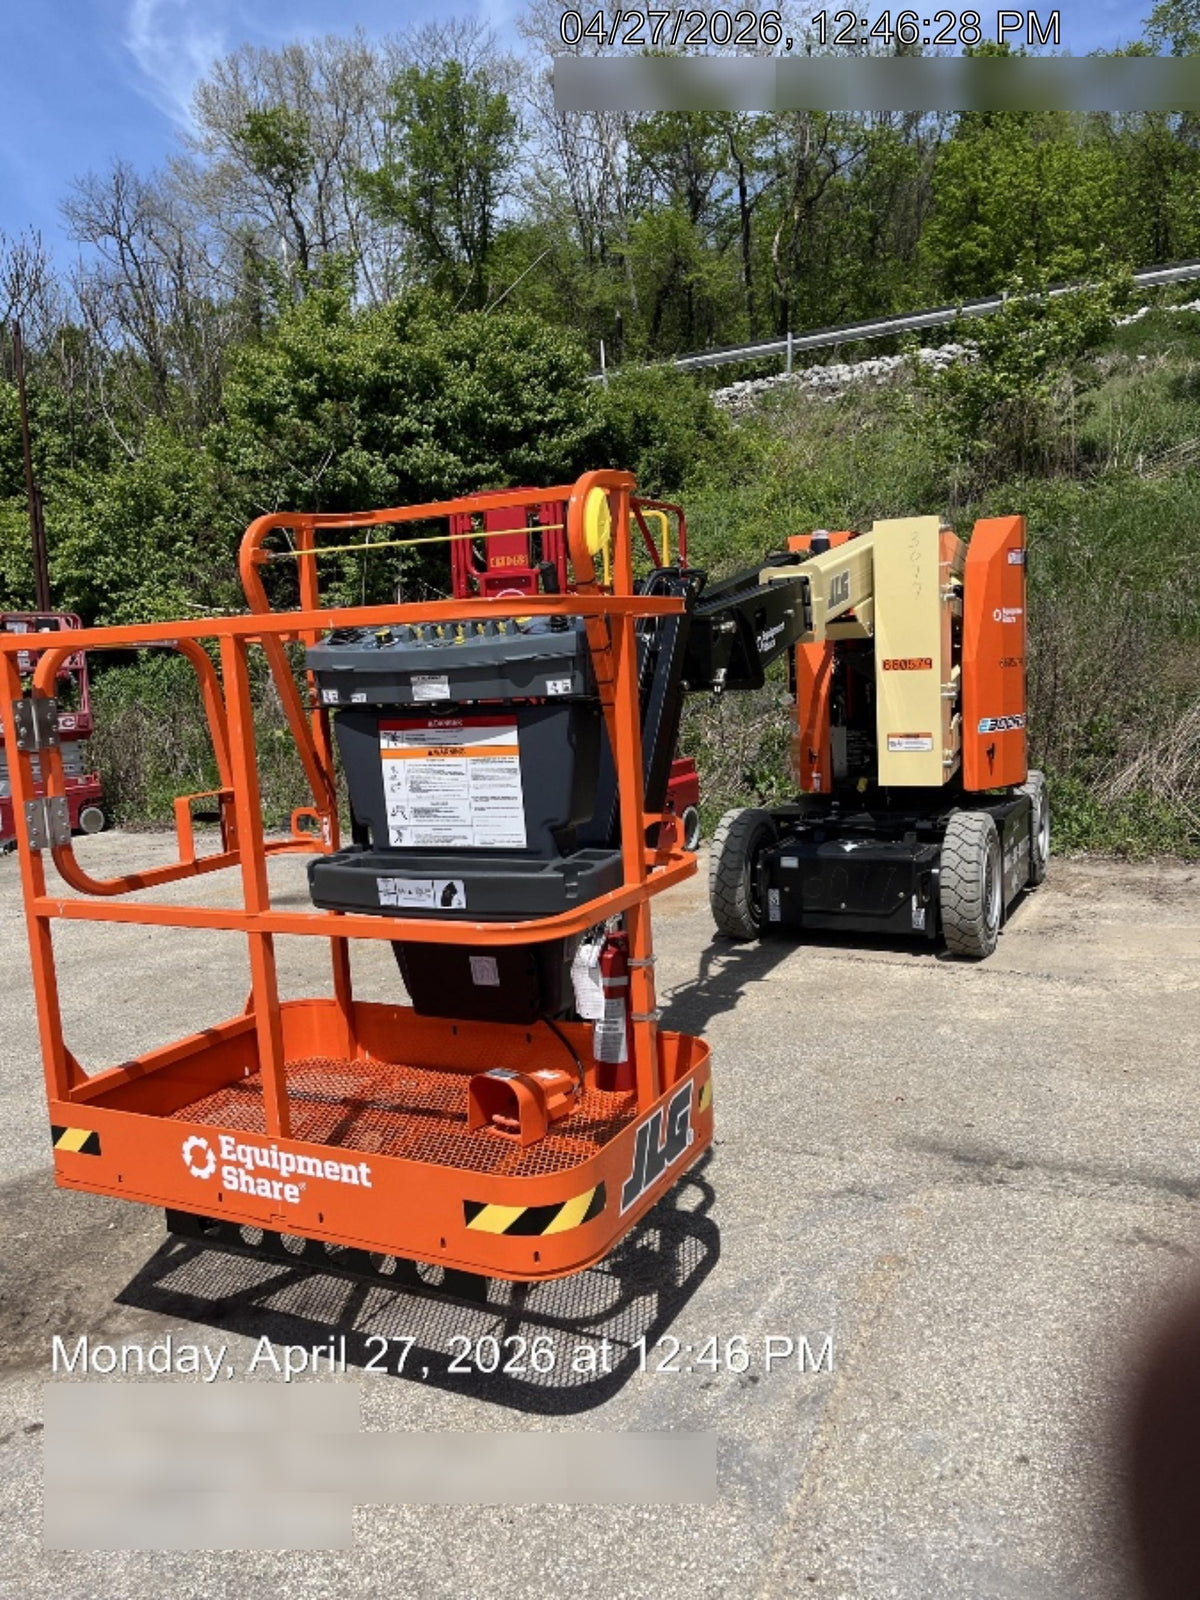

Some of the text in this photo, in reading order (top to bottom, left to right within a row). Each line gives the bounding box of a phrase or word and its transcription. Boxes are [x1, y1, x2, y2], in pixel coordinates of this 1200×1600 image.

[826, 568, 850, 613] JLG
[218, 1134, 373, 1188] Equipment
[619, 1077, 695, 1217] JLG
